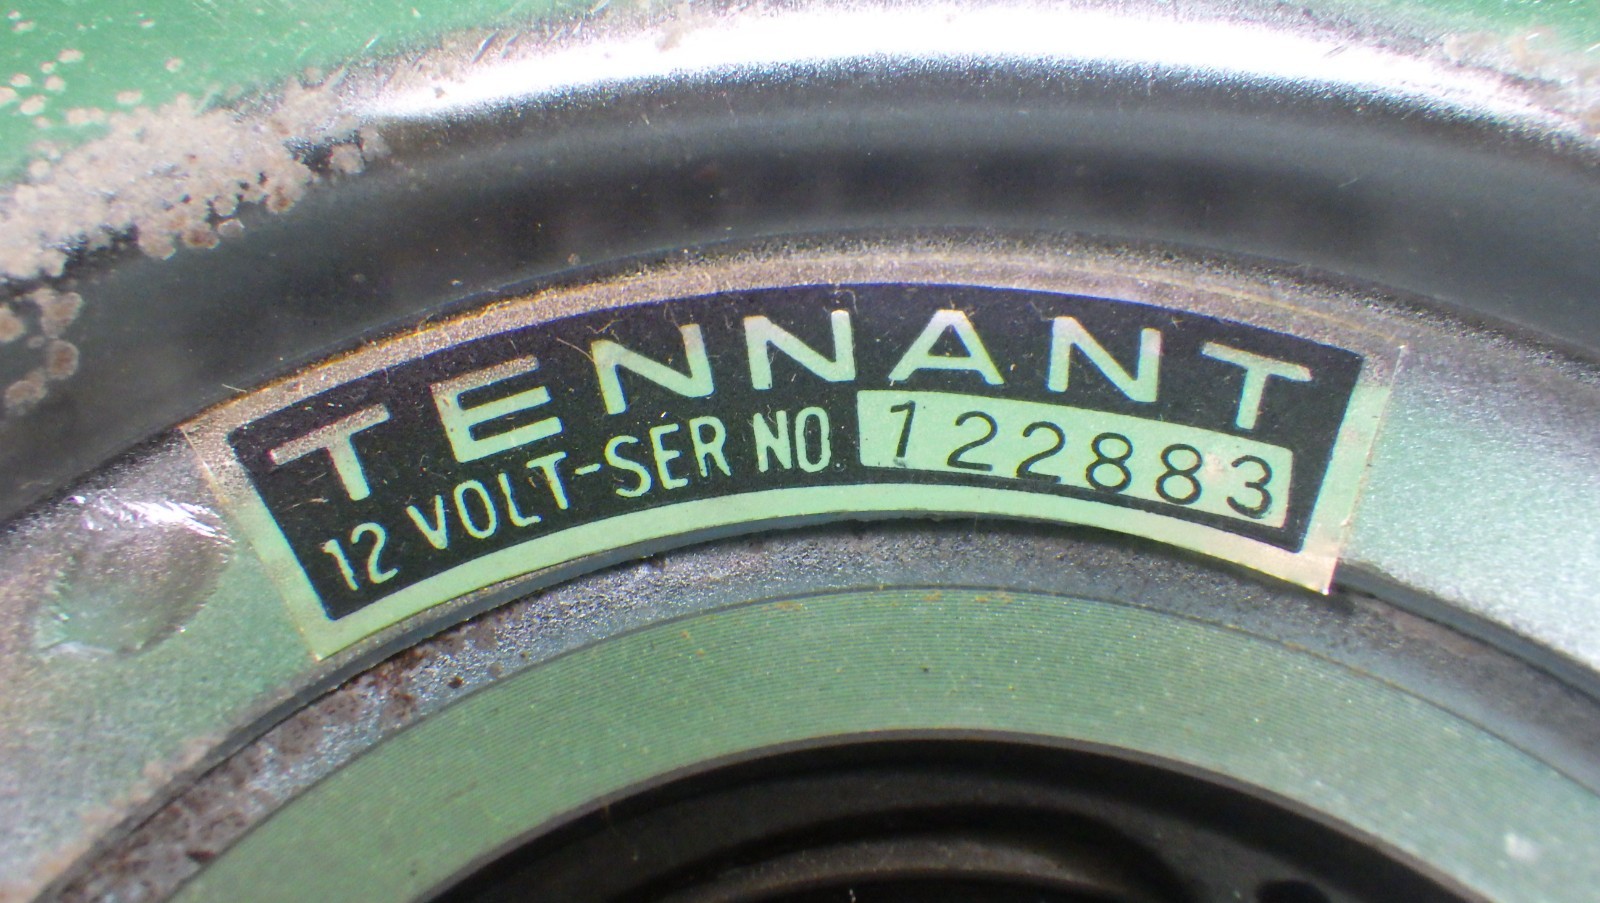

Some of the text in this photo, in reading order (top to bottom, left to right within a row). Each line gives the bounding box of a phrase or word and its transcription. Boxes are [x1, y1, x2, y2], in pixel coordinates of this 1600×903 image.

[269, 309, 1312, 500] TENNANT
[322, 522, 398, 591] 12
[752, 406, 832, 473] NO
[889, 400, 1273, 518] 122883
